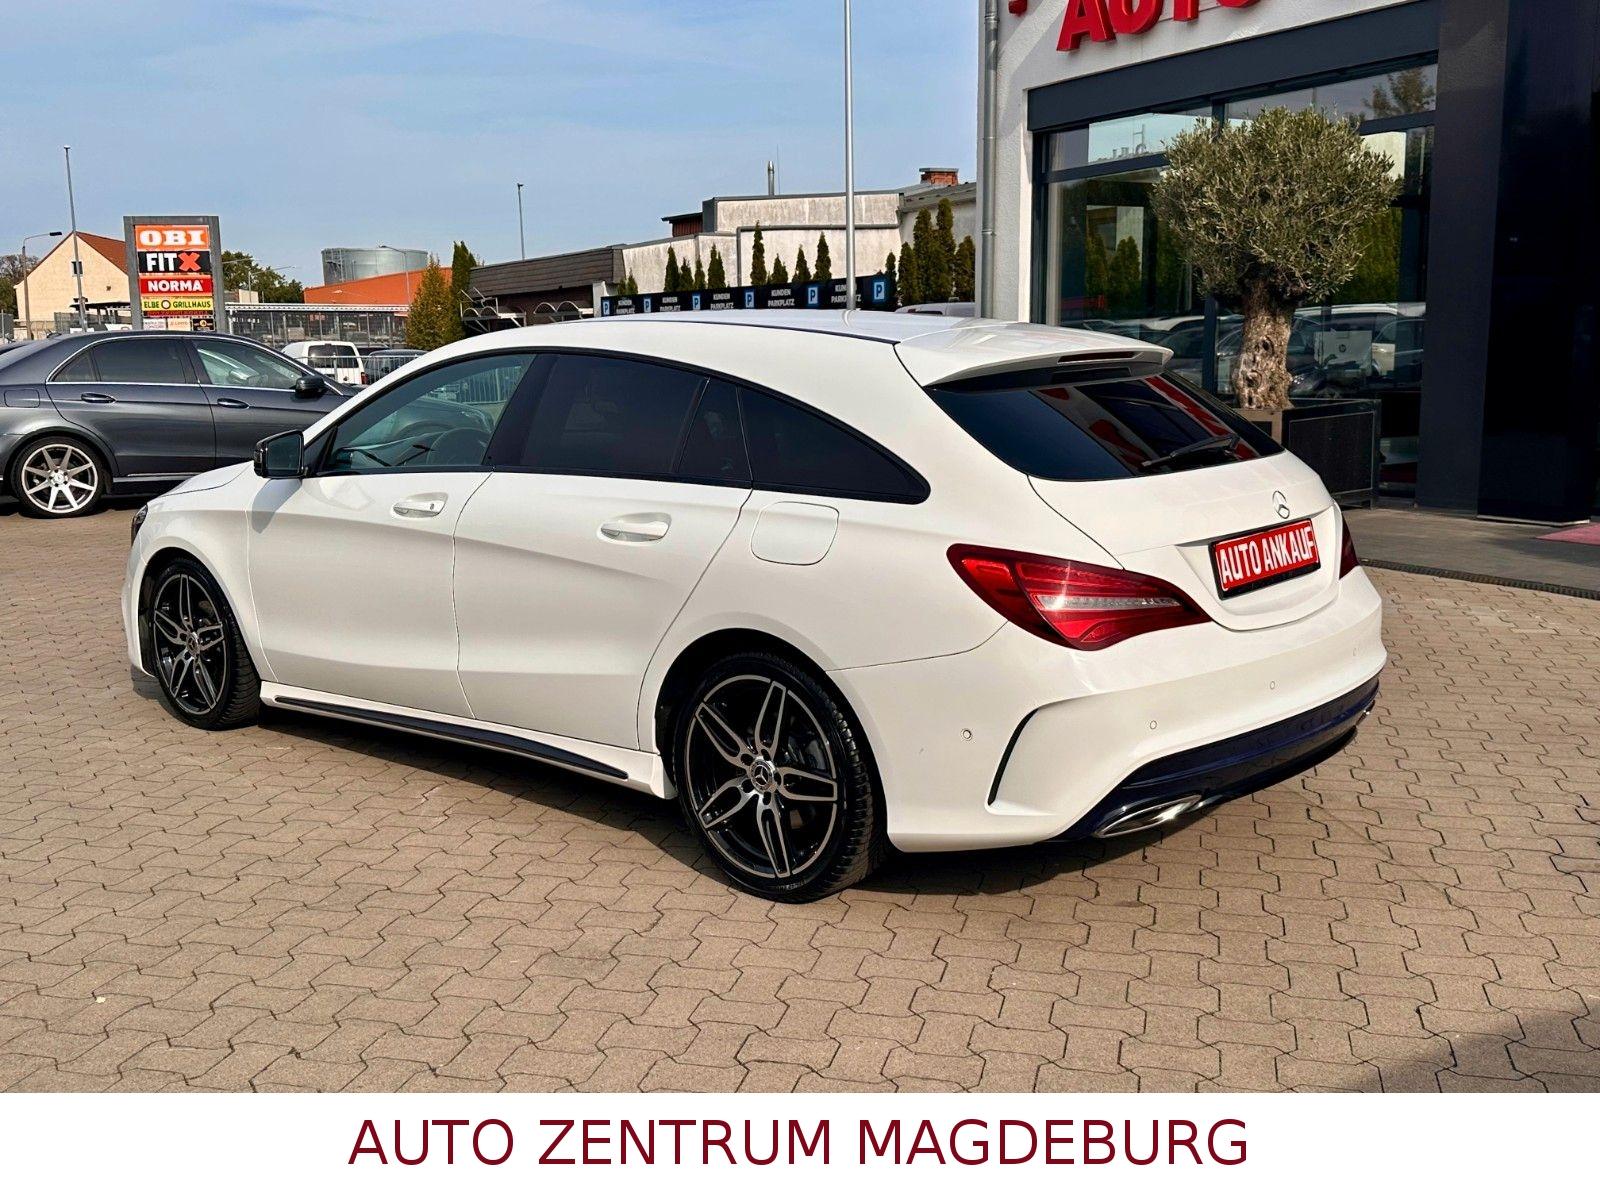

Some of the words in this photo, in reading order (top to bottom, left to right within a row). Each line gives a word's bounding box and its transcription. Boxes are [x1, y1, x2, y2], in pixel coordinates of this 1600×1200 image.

[1056, 0, 1262, 52] AU
[140, 230, 205, 246] OBI
[147, 280, 204, 292] NORMA
[771, 289, 791, 297] KUNDEN
[710, 302, 734, 310] PARKPLATZ
[767, 298, 795, 307] PARKPLATZ
[1219, 540, 1262, 584] AUTO
[1262, 526, 1314, 571] ANKAUF
